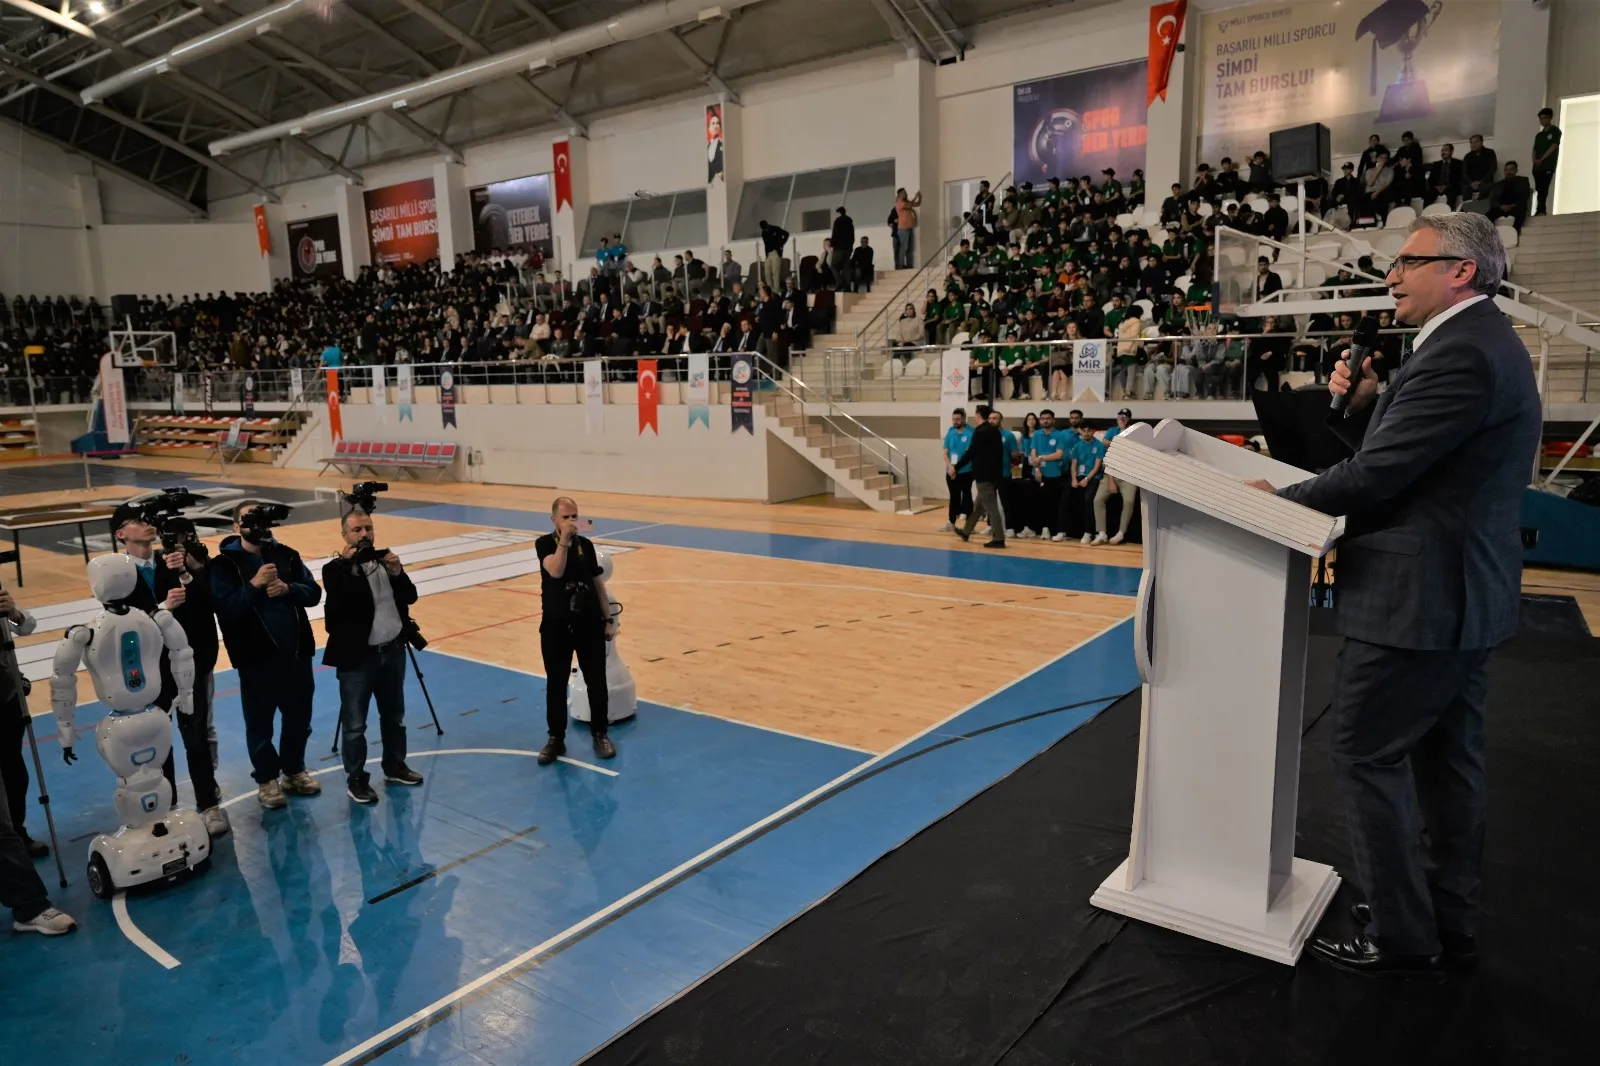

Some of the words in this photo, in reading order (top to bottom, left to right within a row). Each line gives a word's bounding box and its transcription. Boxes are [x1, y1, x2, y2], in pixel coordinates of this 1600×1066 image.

[1293, 22, 1336, 42] SPORCU
[1216, 53, 1258, 80] ŞİMDİ
[1216, 80, 1245, 99] TAM
[1249, 68, 1314, 95] BURSLU!
[396, 222, 413, 239] TAM
[524, 222, 550, 242] YERDE
